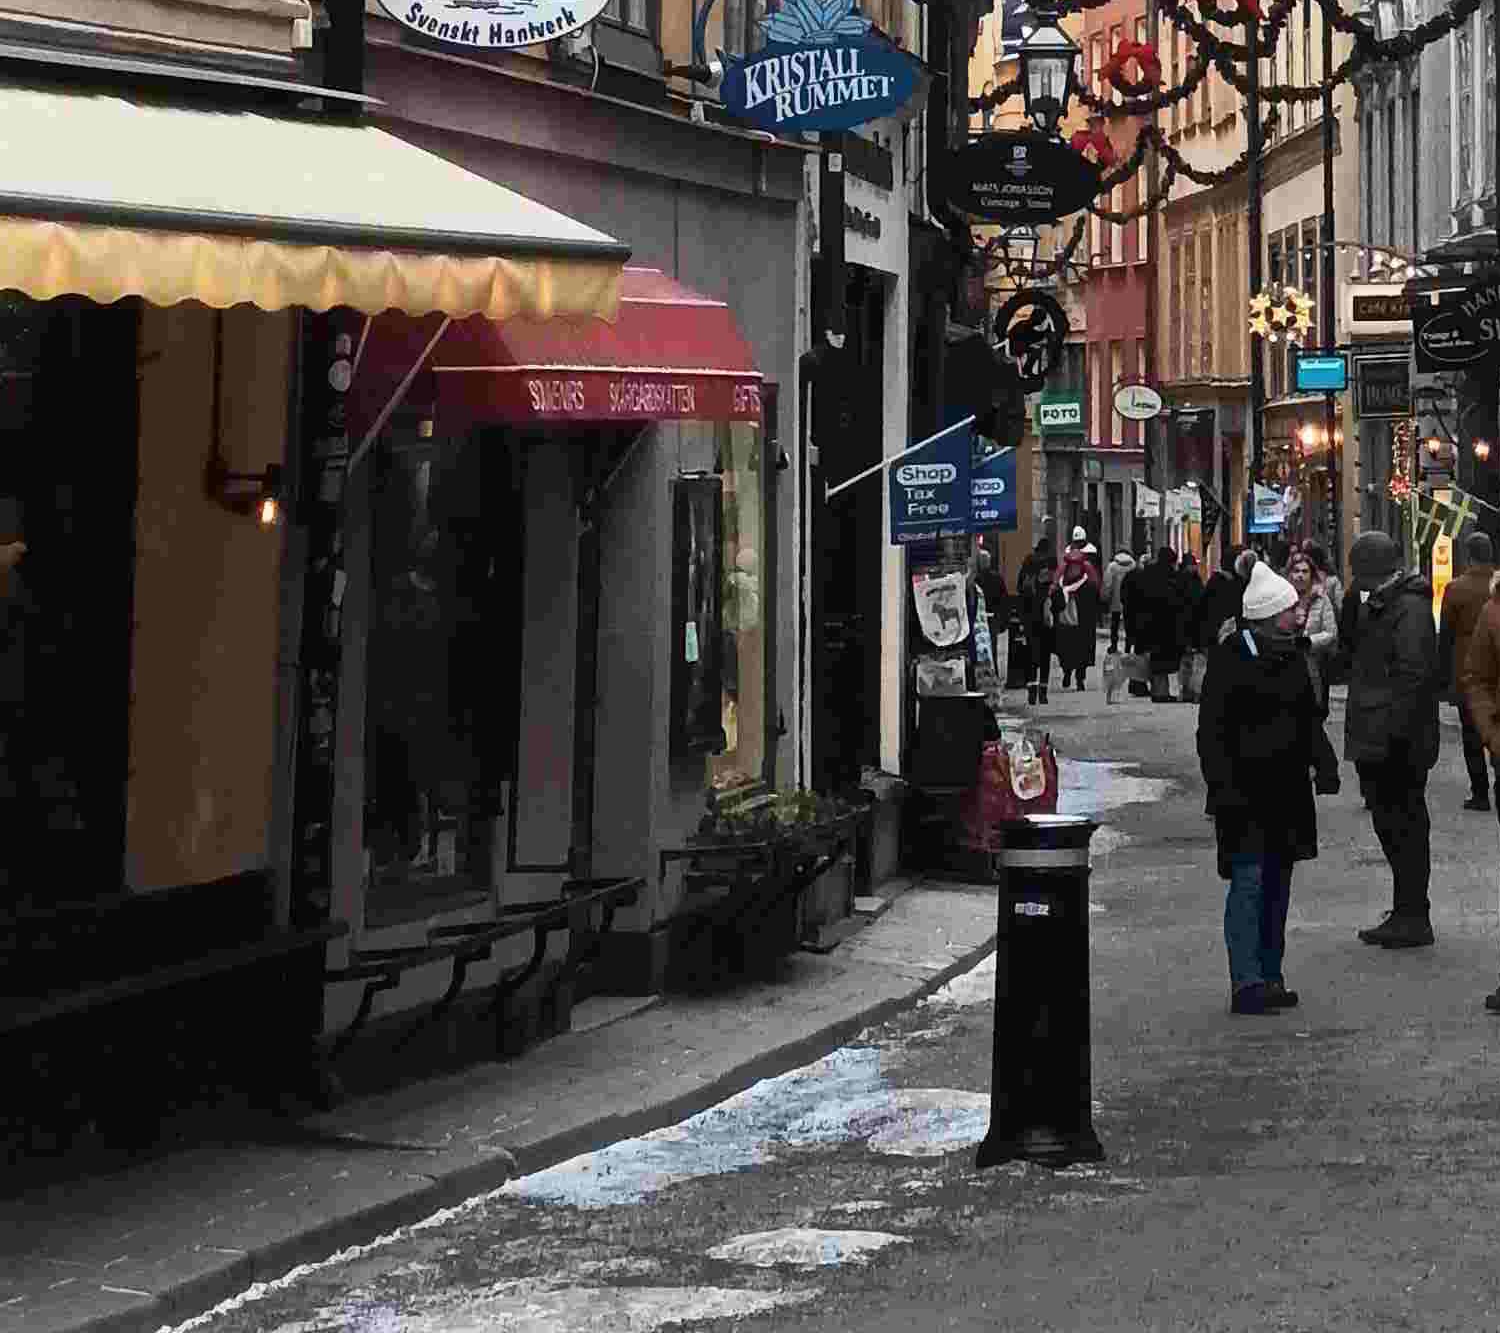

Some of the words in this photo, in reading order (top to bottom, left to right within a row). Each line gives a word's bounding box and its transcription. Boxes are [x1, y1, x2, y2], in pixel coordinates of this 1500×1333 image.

[405, 3, 480, 45] Svenskt
[489, 7, 577, 45] Hantverk
[743, 48, 866, 109] KRISTALL
[775, 76, 890, 122] RUMMET
[1042, 407, 1079, 420] FOTO
[902, 466, 953, 482] Shop
[903, 487, 937, 501] Tax
[907, 503, 950, 516] Free
